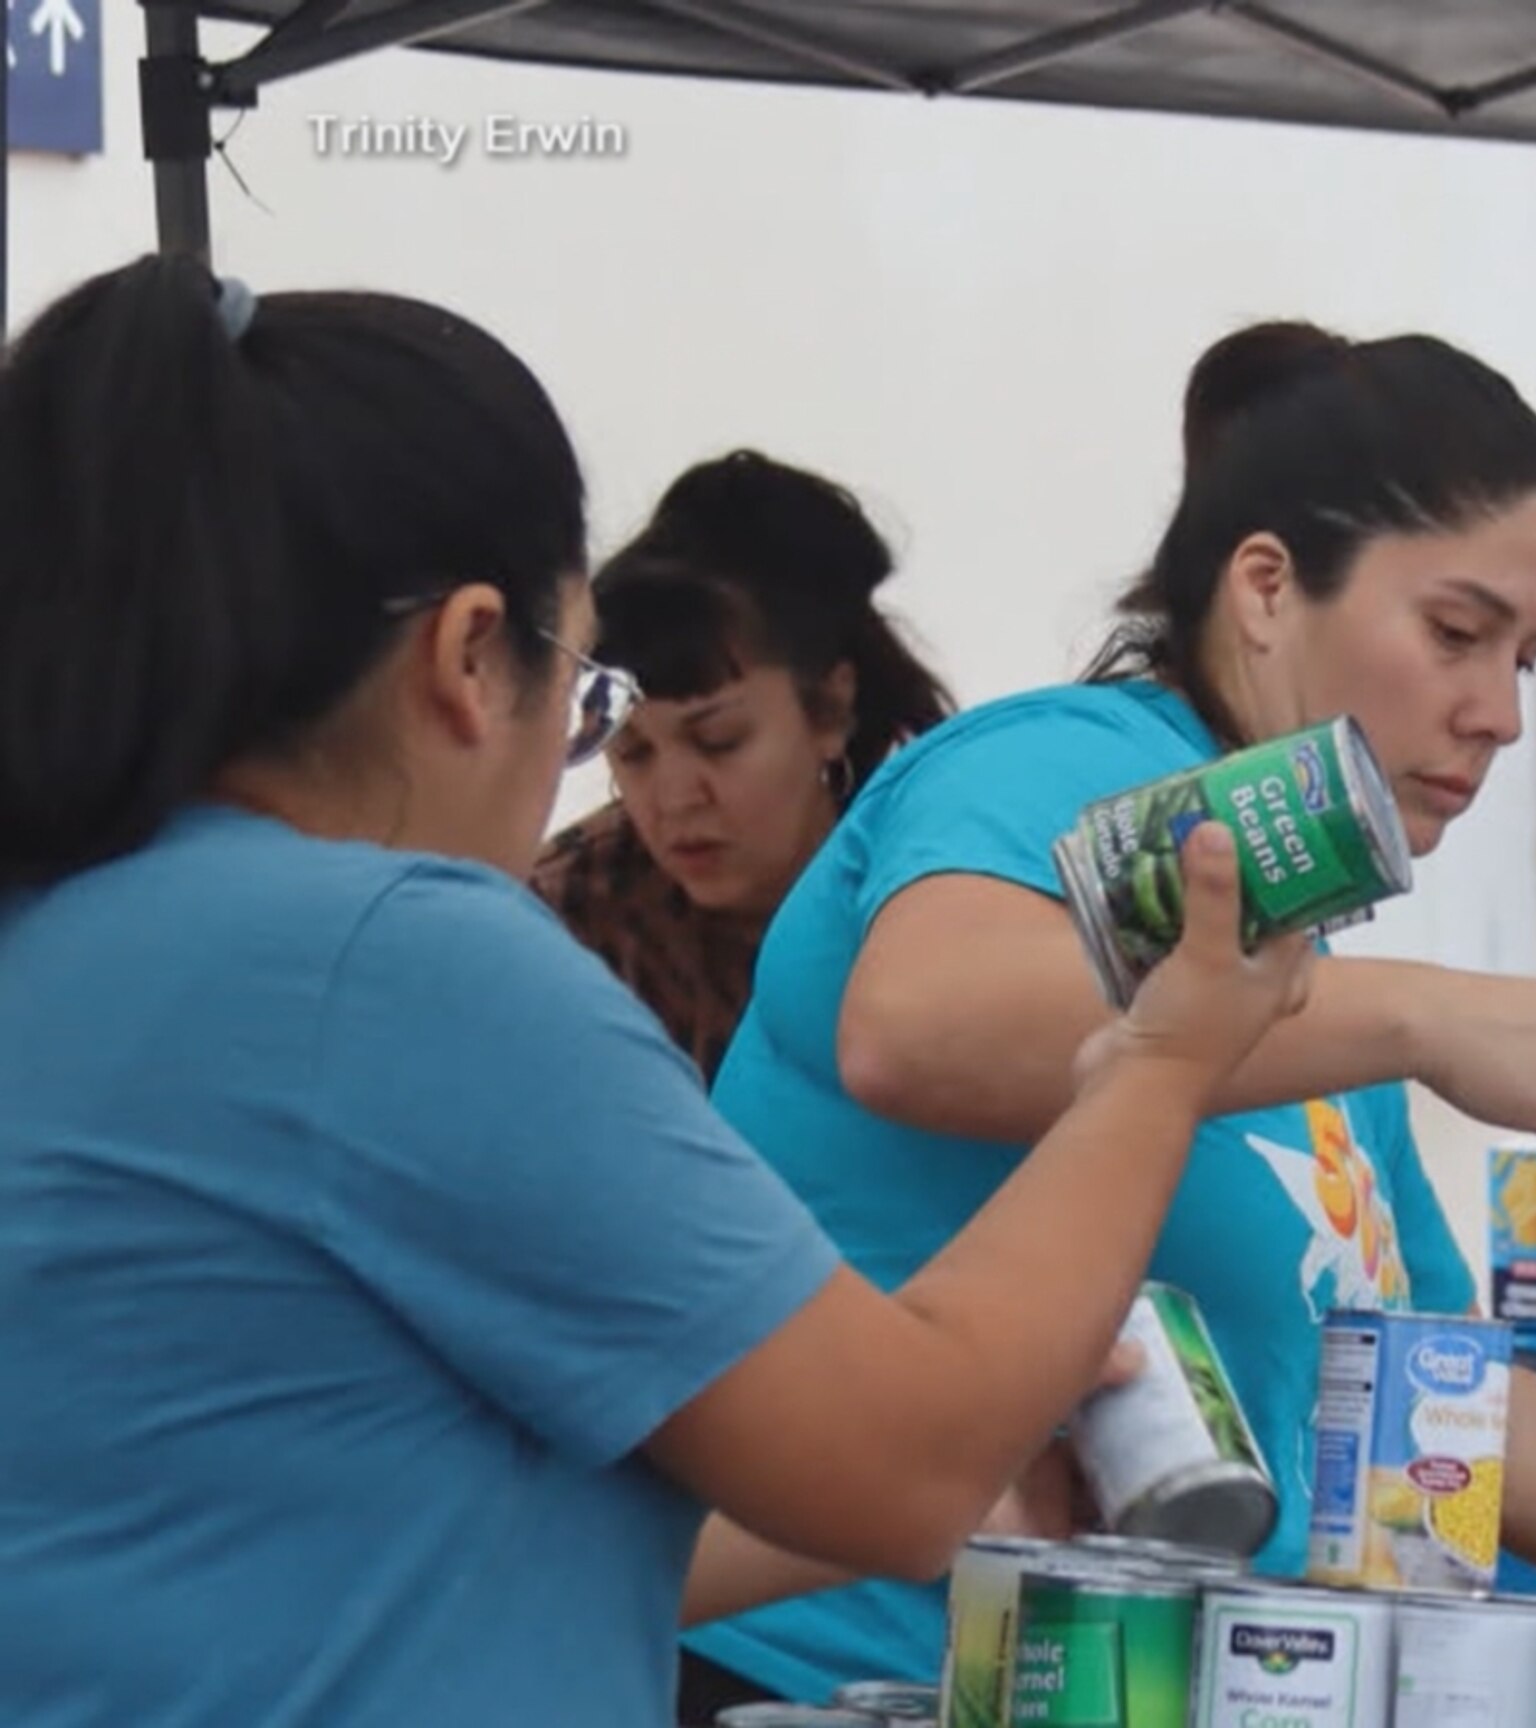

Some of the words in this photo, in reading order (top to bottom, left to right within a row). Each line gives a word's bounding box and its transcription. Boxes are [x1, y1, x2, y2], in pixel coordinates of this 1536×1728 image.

[1229, 784, 1287, 886] Beans
[1259, 775, 1316, 875] Green
[1014, 1638, 1065, 1662] hole
